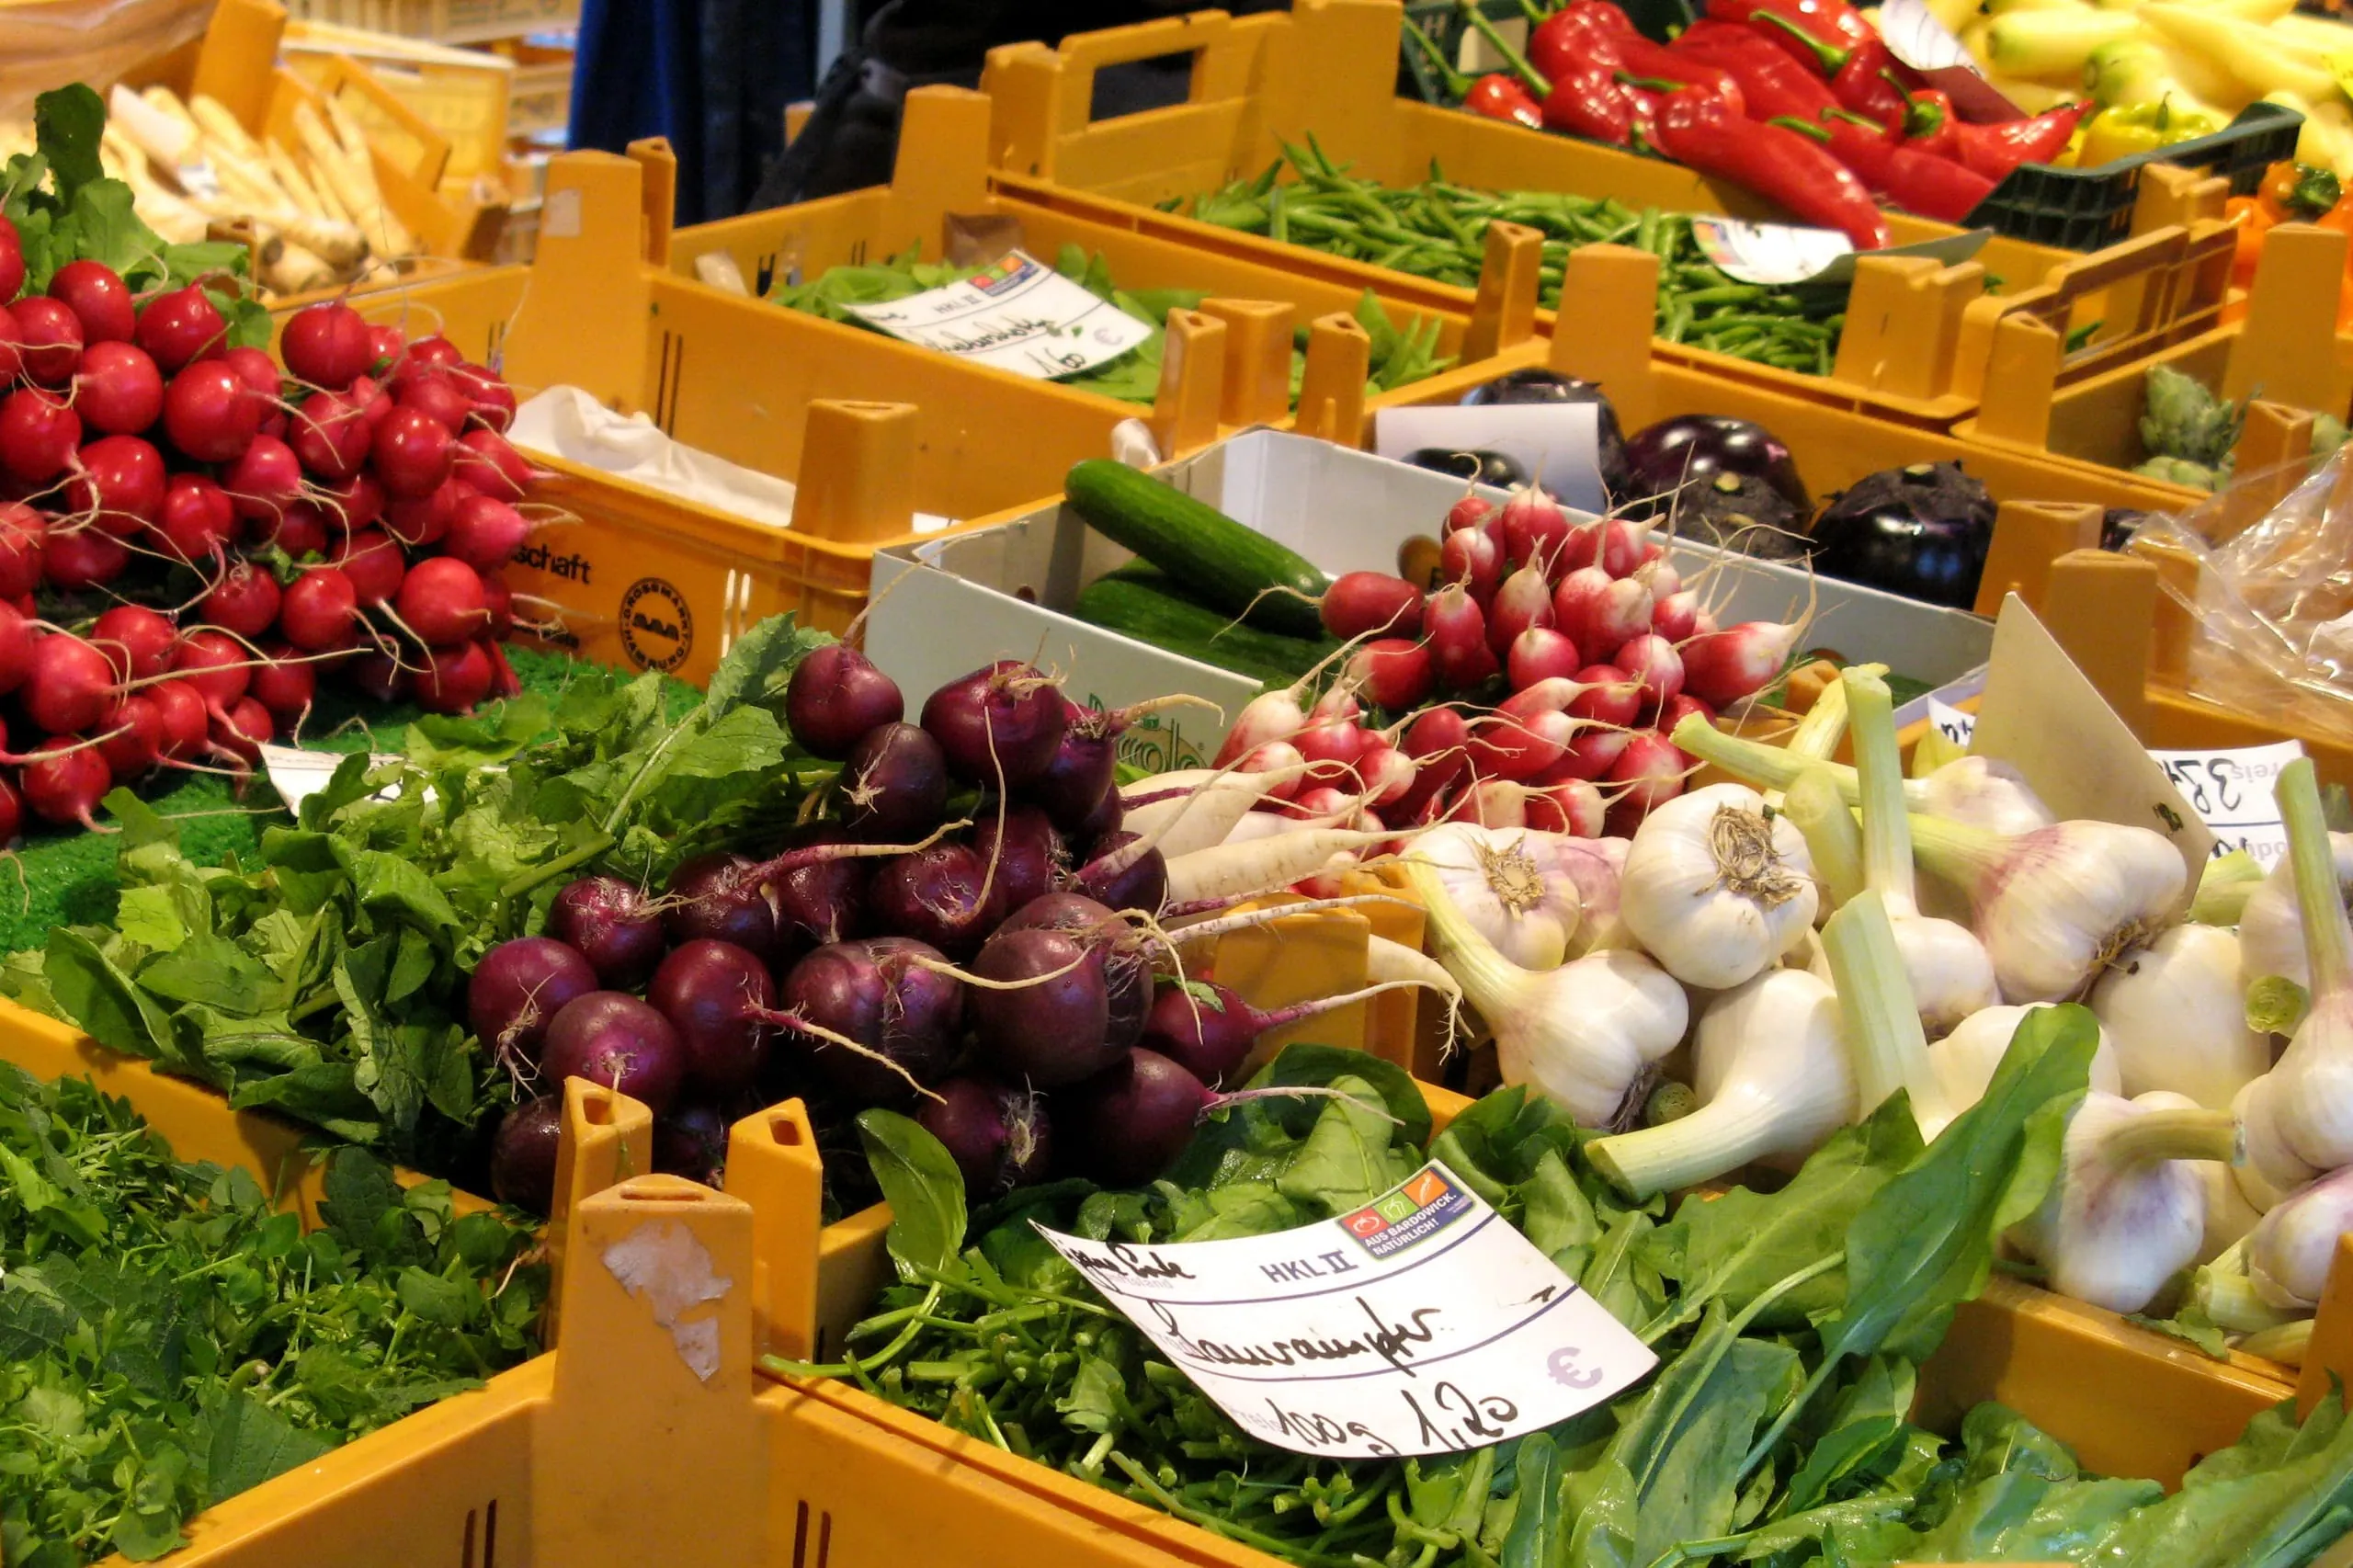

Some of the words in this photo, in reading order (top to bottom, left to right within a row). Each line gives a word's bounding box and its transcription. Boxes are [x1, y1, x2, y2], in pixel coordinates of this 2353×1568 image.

[1364, 1233, 1389, 1249] AUS
[1388, 1193, 1458, 1235] BARDOWICK.
[1372, 1219, 1439, 1256] NATÜRLICH!
[1258, 1259, 1328, 1283] HKL
[1318, 1249, 1359, 1275] II
[1546, 1346, 1604, 1389] €
[1401, 1381, 1518, 1451] 1,20
